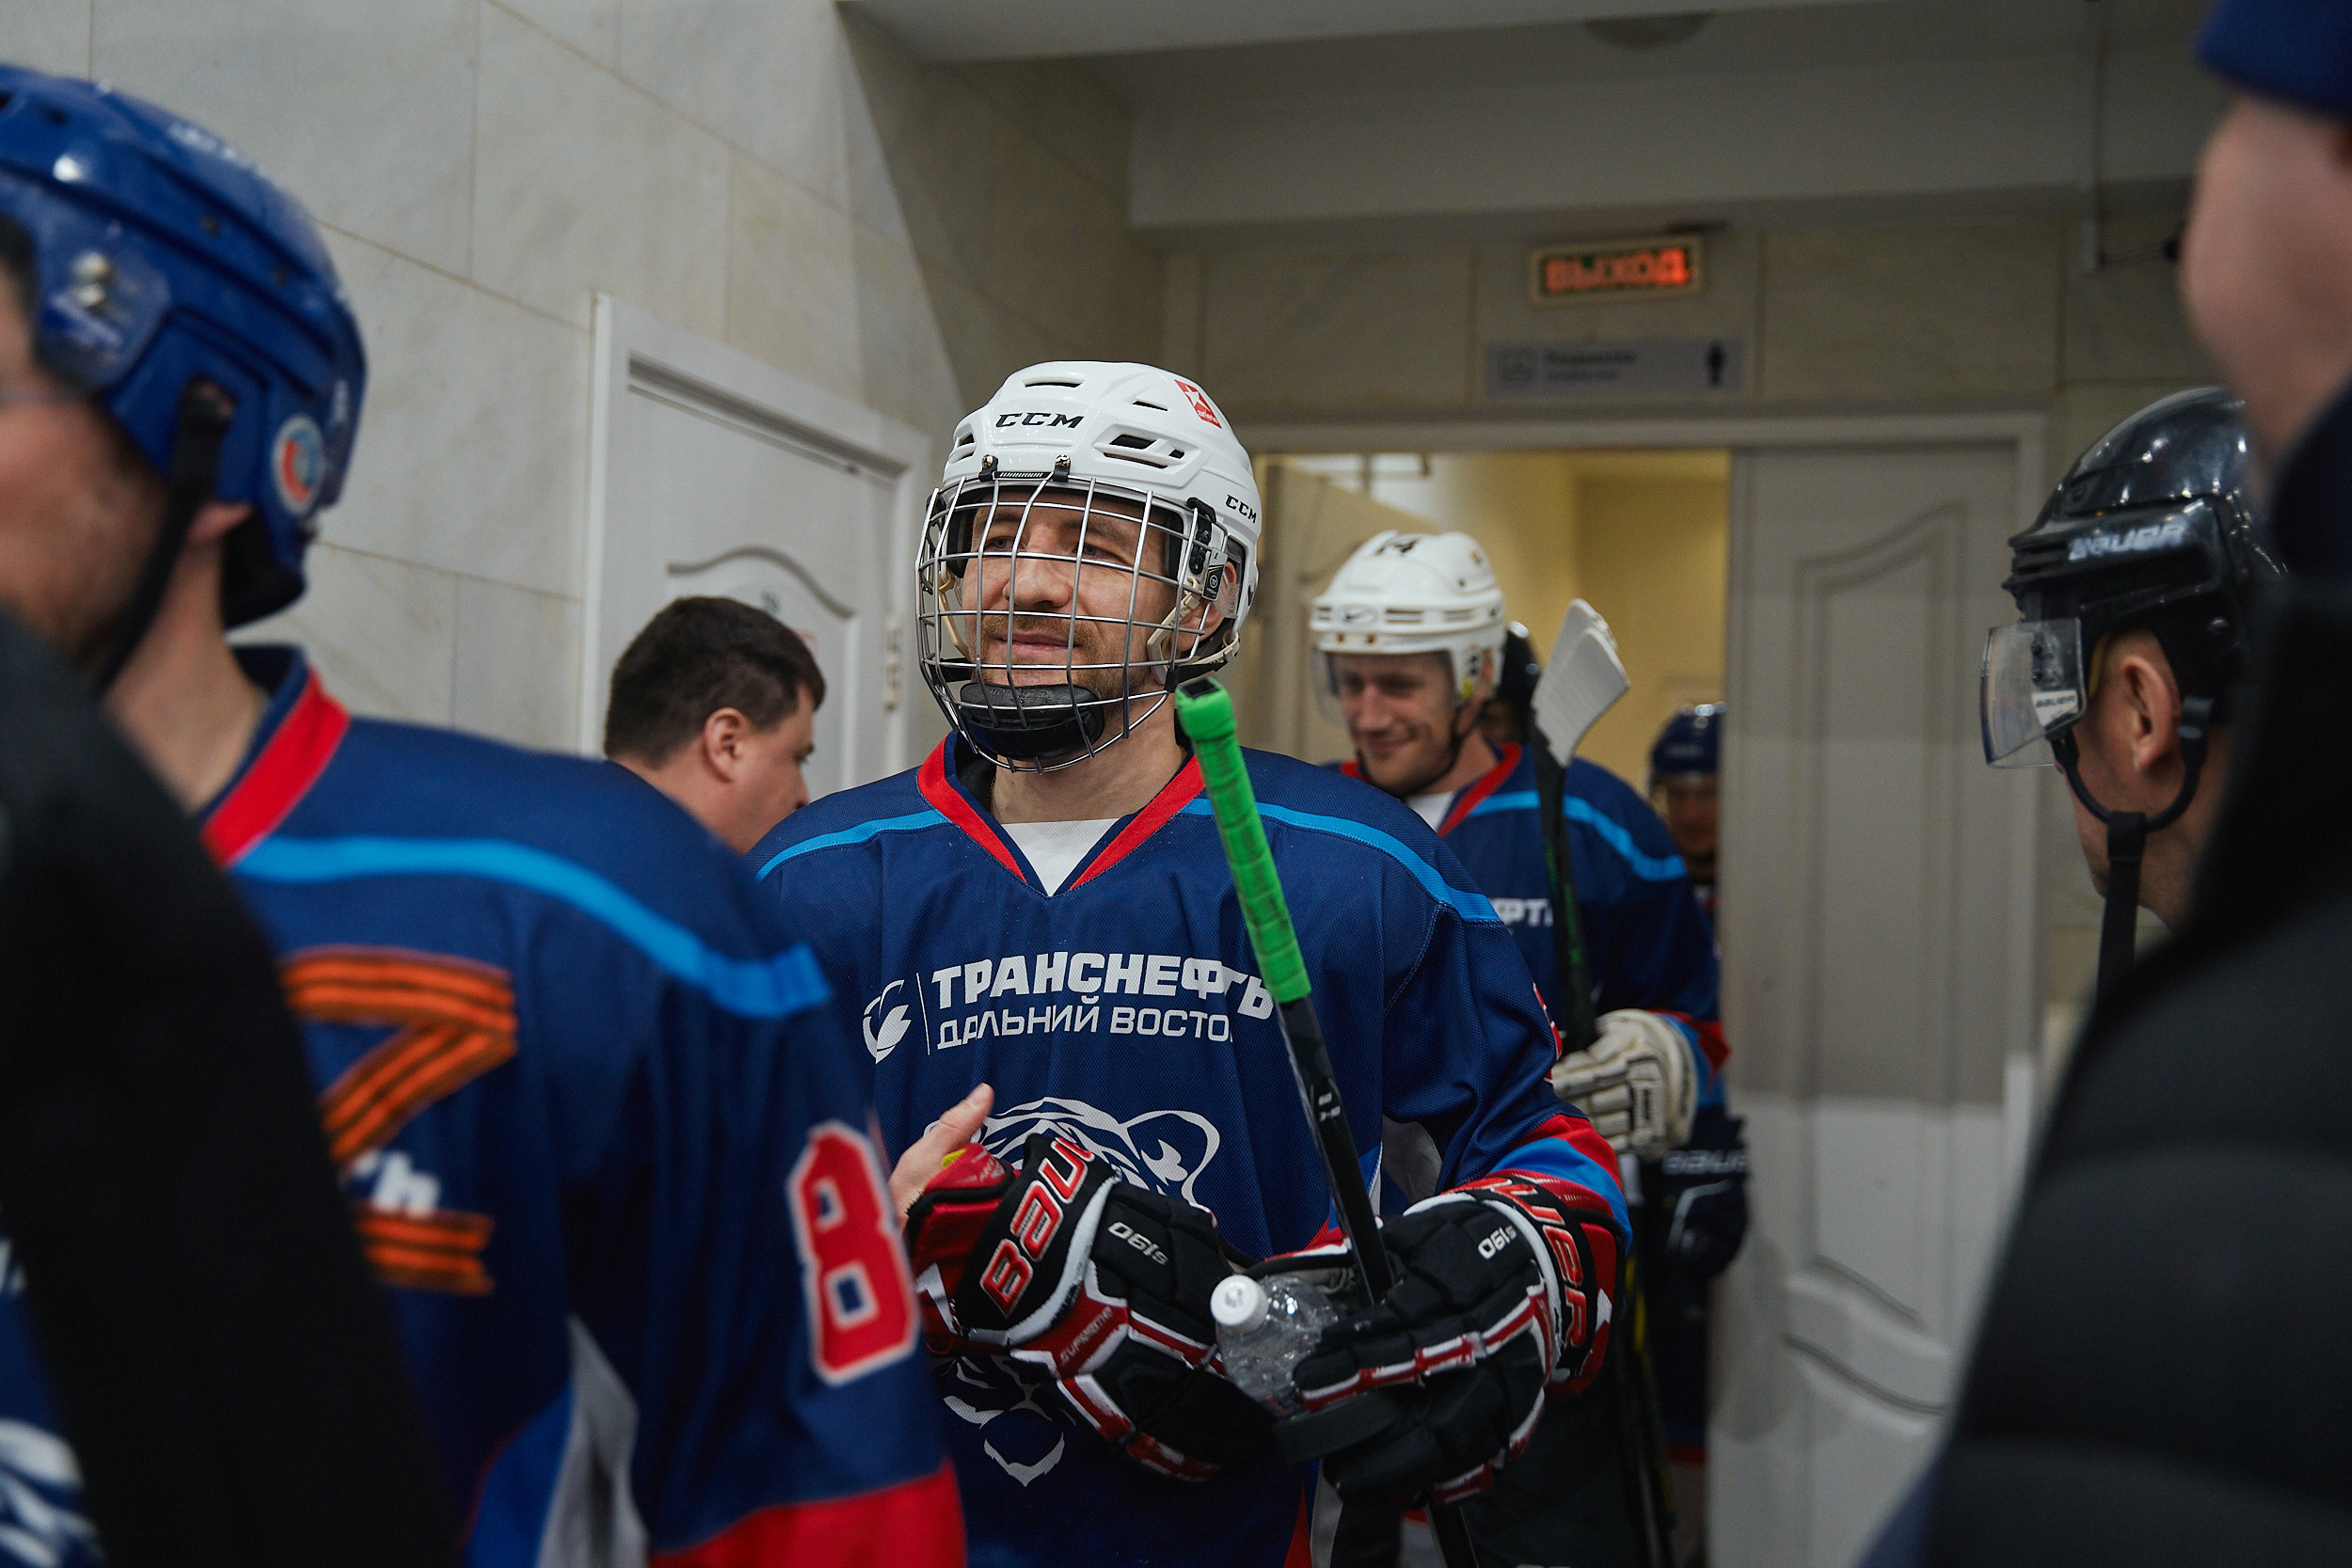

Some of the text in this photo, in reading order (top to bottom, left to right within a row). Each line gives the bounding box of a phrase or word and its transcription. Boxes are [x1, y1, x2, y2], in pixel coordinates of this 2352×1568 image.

[1545, 247, 1688, 294] ВЫХОД
[995, 412, 1085, 429] CCM
[1225, 494, 1257, 524] CCM
[930, 951, 1274, 1021] ТРАНСНЕФТЬ
[937, 995, 1233, 1050] ДАЛЬНИЙ ВОСТО
[785, 1118, 923, 1388] 8
[979, 1136, 1096, 1319] BAU
